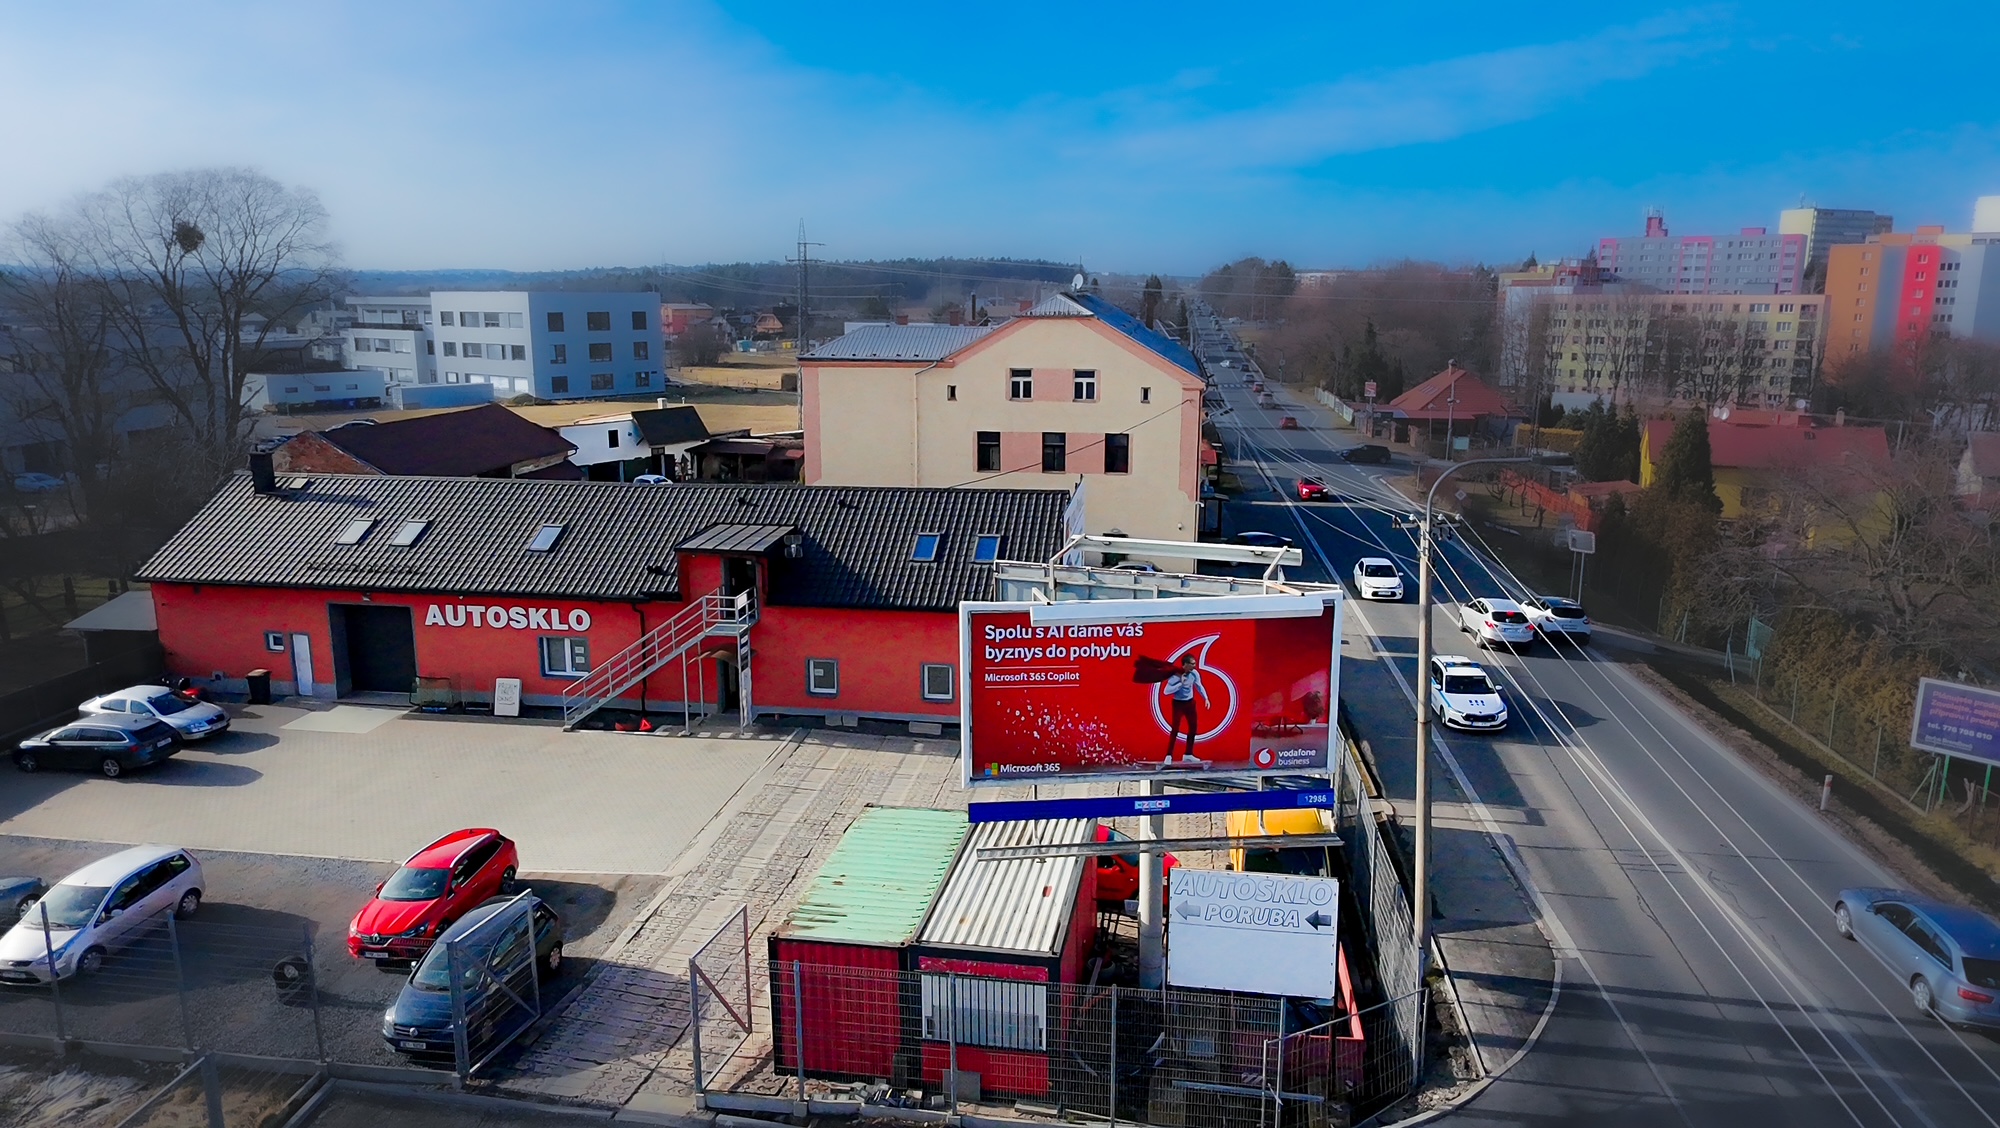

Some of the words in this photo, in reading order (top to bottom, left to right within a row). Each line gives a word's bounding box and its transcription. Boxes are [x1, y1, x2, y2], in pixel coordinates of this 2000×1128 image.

[425, 604, 591, 632] AUTOSKLO
[985, 624, 1032, 642] Spolu
[1036, 627, 1044, 638] s
[1047, 626, 1064, 638] AI
[1114, 622, 1144, 637] váš
[985, 645, 1043, 662] byznys
[1046, 644, 1066, 658] do
[1070, 643, 1131, 660] pohybu
[984, 673, 1028, 682] Microsoft
[1029, 672, 1045, 681] 365
[1047, 671, 1080, 682] Copilot
[1927, 722, 1940, 730] tel.
[1278, 748, 1316, 757] vodafone
[1000, 763, 1043, 772] Microsoft
[1044, 763, 1060, 772] 365
[1278, 758, 1310, 766] business
[1174, 873, 1333, 906] AUTOSKLO
[1204, 904, 1300, 928] PORUBA
